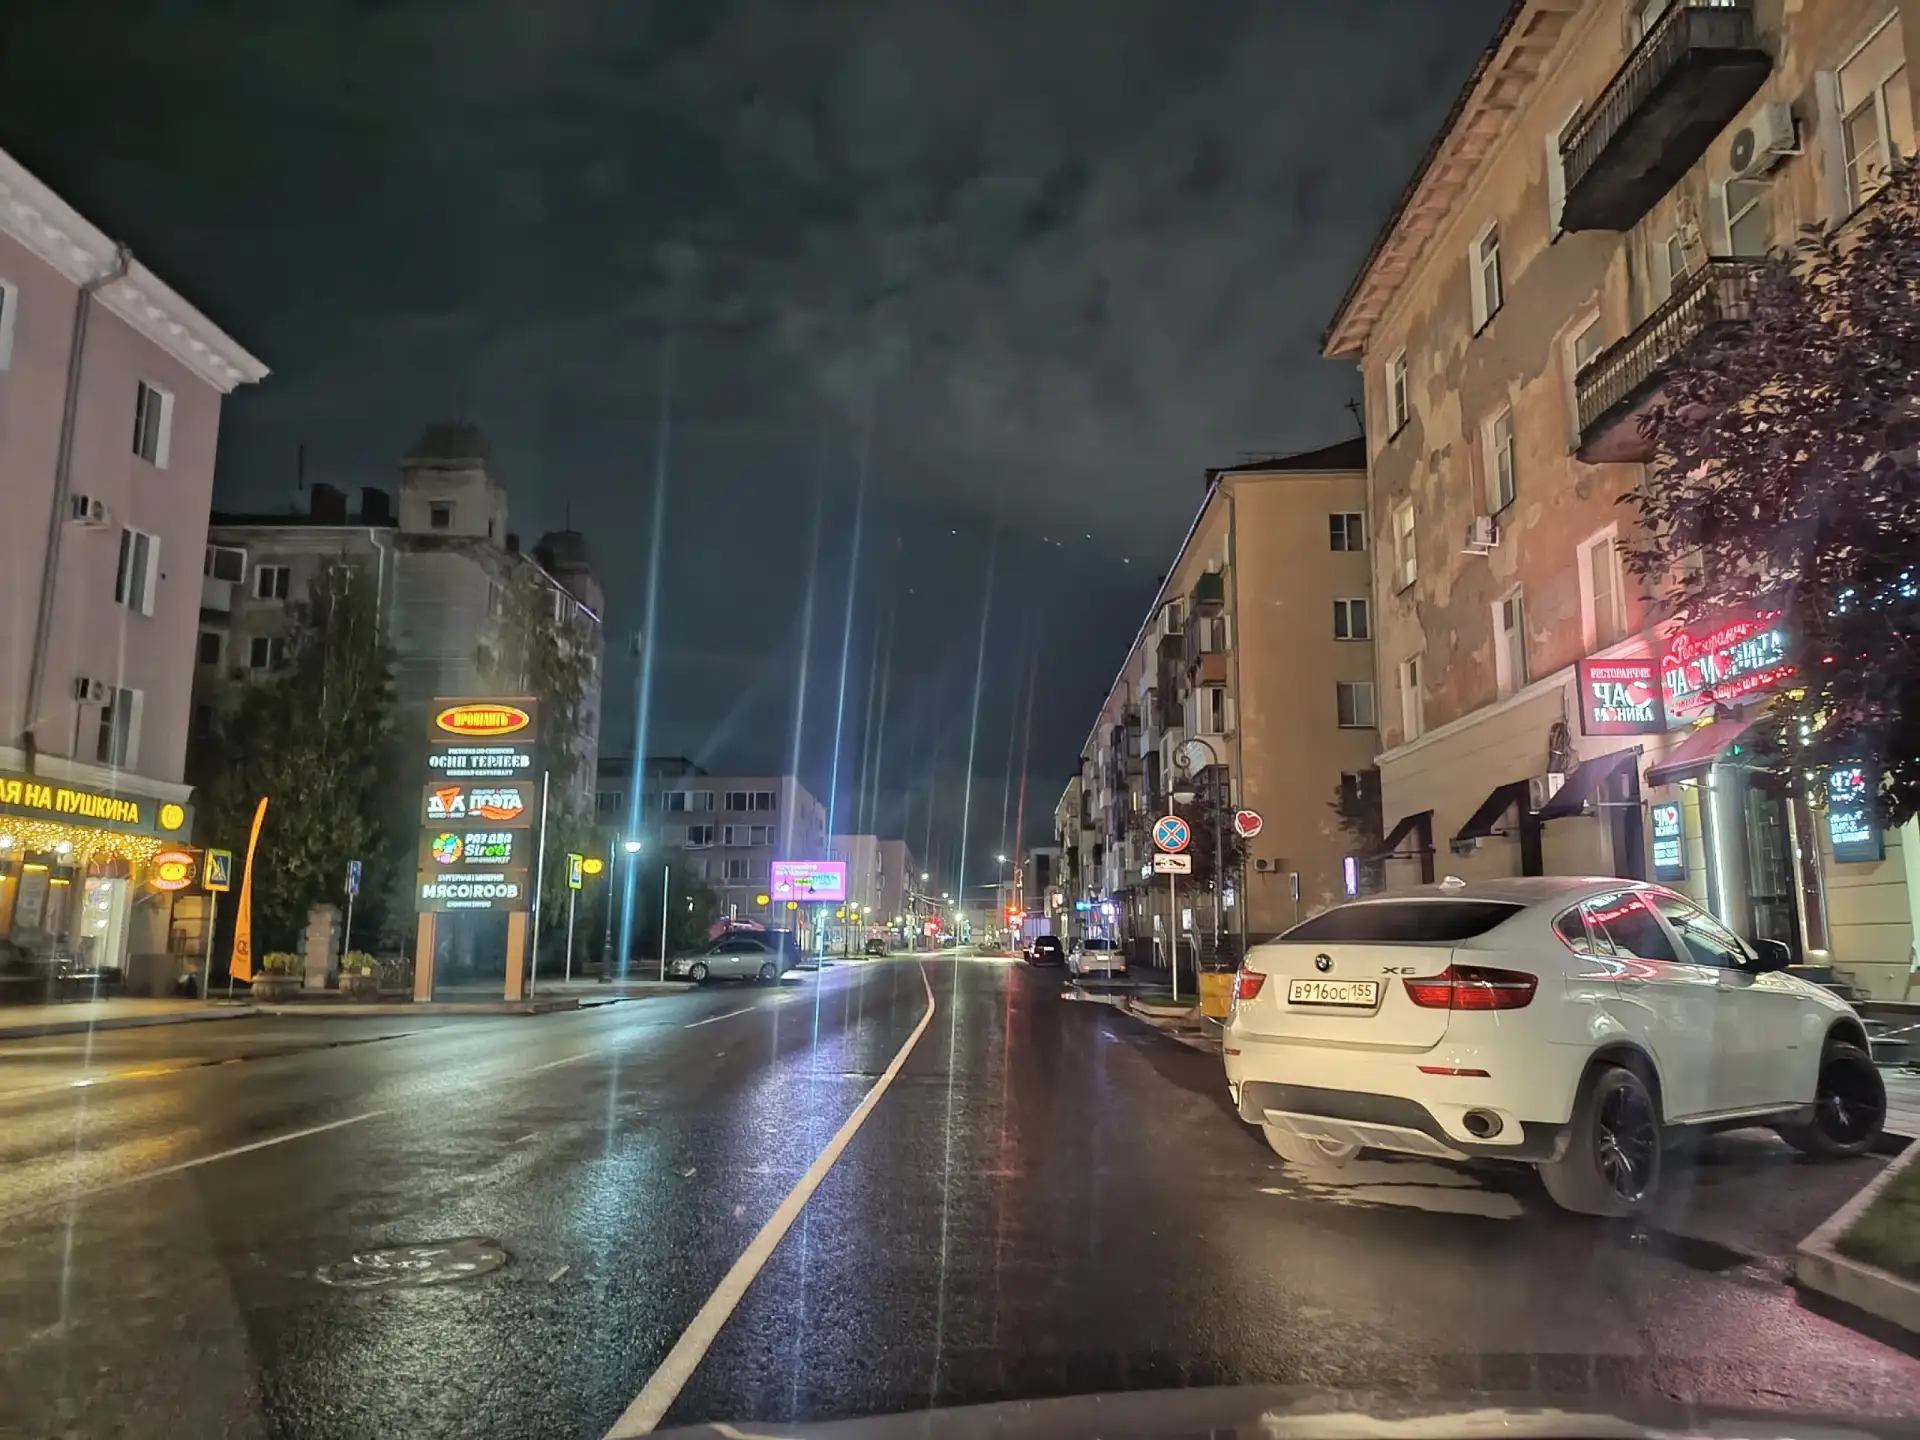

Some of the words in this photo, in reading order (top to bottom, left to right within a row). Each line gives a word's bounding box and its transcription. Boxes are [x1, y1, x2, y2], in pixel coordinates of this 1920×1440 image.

[428, 755, 467, 768] ОСИП
[25, 784, 52, 810] НА
[55, 788, 139, 824] ПУШКИНА
[469, 794, 523, 809] ПОЭТА
[465, 833, 487, 844] РАЗ
[487, 833, 513, 844] ДВА
[464, 843, 511, 856] Street
